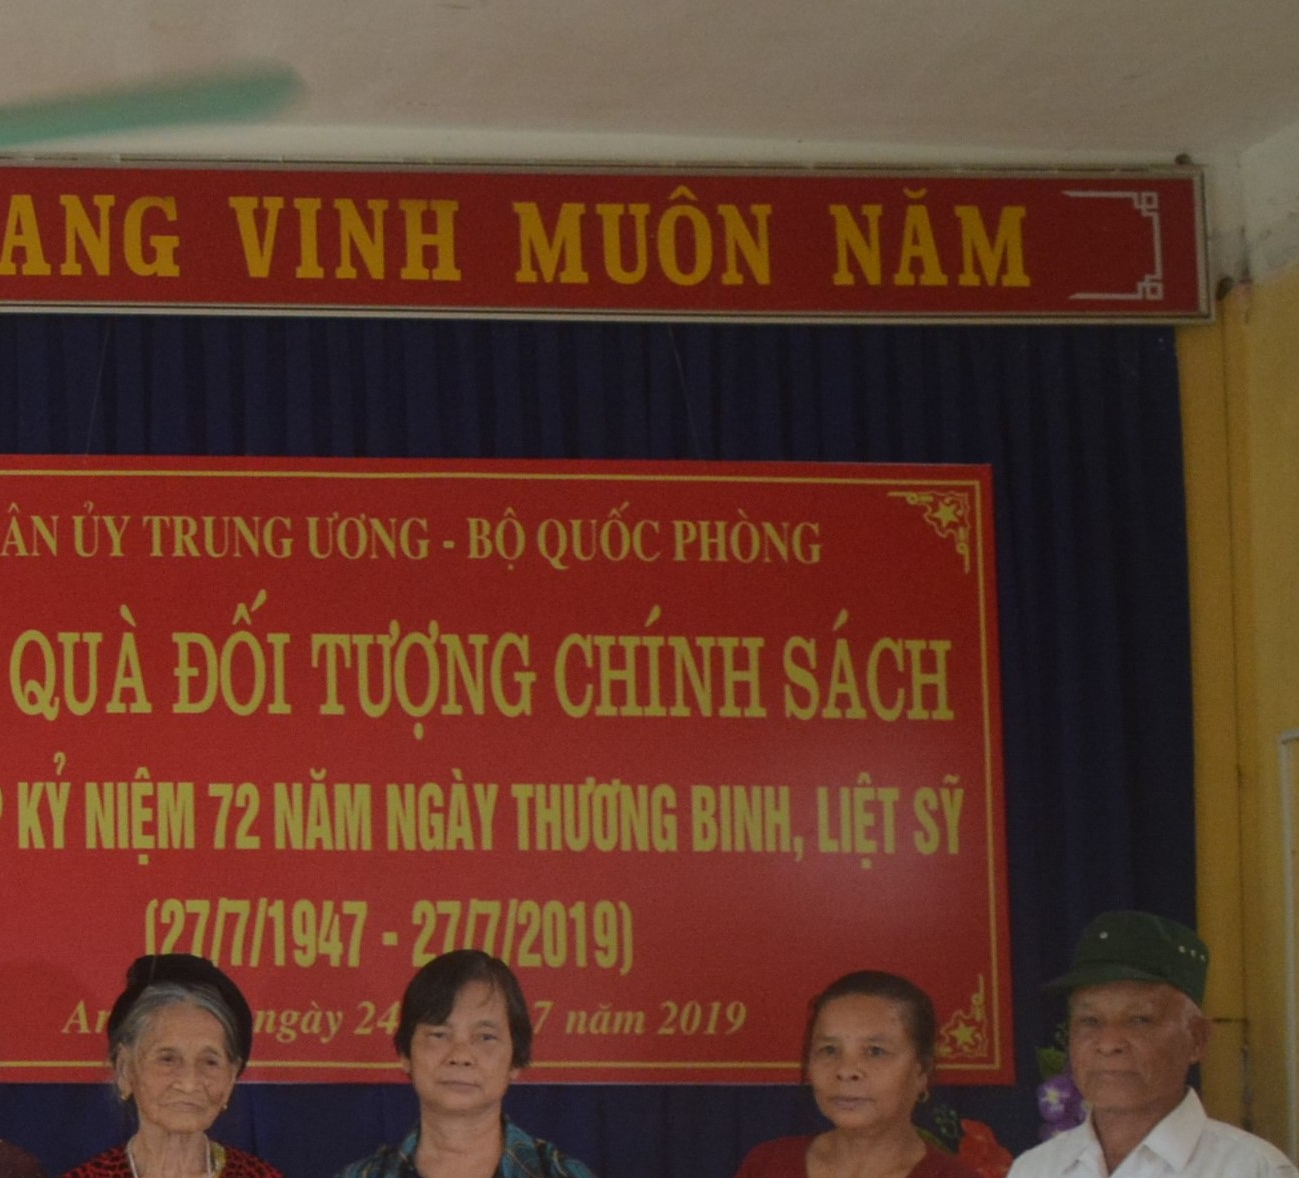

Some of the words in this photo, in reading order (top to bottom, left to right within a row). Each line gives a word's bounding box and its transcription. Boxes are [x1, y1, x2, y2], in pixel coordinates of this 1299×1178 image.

[229, 195, 463, 282] VINH
[512, 185, 773, 287] MUÔN
[828, 189, 1031, 288] NĂM
[72, 501, 131, 558] ỦY
[142, 516, 294, 559] TRUNG
[306, 511, 430, 560] ƯƠNG
[442, 539, 455, 550] -
[467, 506, 526, 571] BỘ
[536, 501, 661, 571] QUỐC
[672, 508, 822, 565] PHÒNG
[9, 604, 153, 722] QUÀ
[172, 589, 292, 717] ĐỐI
[310, 619, 537, 741] TƯỢNG
[554, 605, 767, 719] CHÍNH
[783, 609, 955, 722] SÁCH
[17, 751, 71, 850] KỶ
[84, 766, 196, 866] NIỆM
[208, 782, 262, 850] 72
[273, 767, 373, 851] NĂM
[386, 768, 498, 852] NGÀY
[510, 776, 678, 853] THƯƠNG
[691, 784, 805, 862] BINH,
[816, 771, 901, 870] LIỆT
[913, 774, 965, 856] SỸ
[145, 897, 368, 968] (27/7/1947
[382, 931, 399, 946] -
[411, 897, 634, 976] 27/7/2019)
[252, 1000, 344, 1044] ngày
[353, 1000, 402, 1036] 24
[564, 1002, 646, 1036] năm
[657, 1000, 748, 1036] 2019
